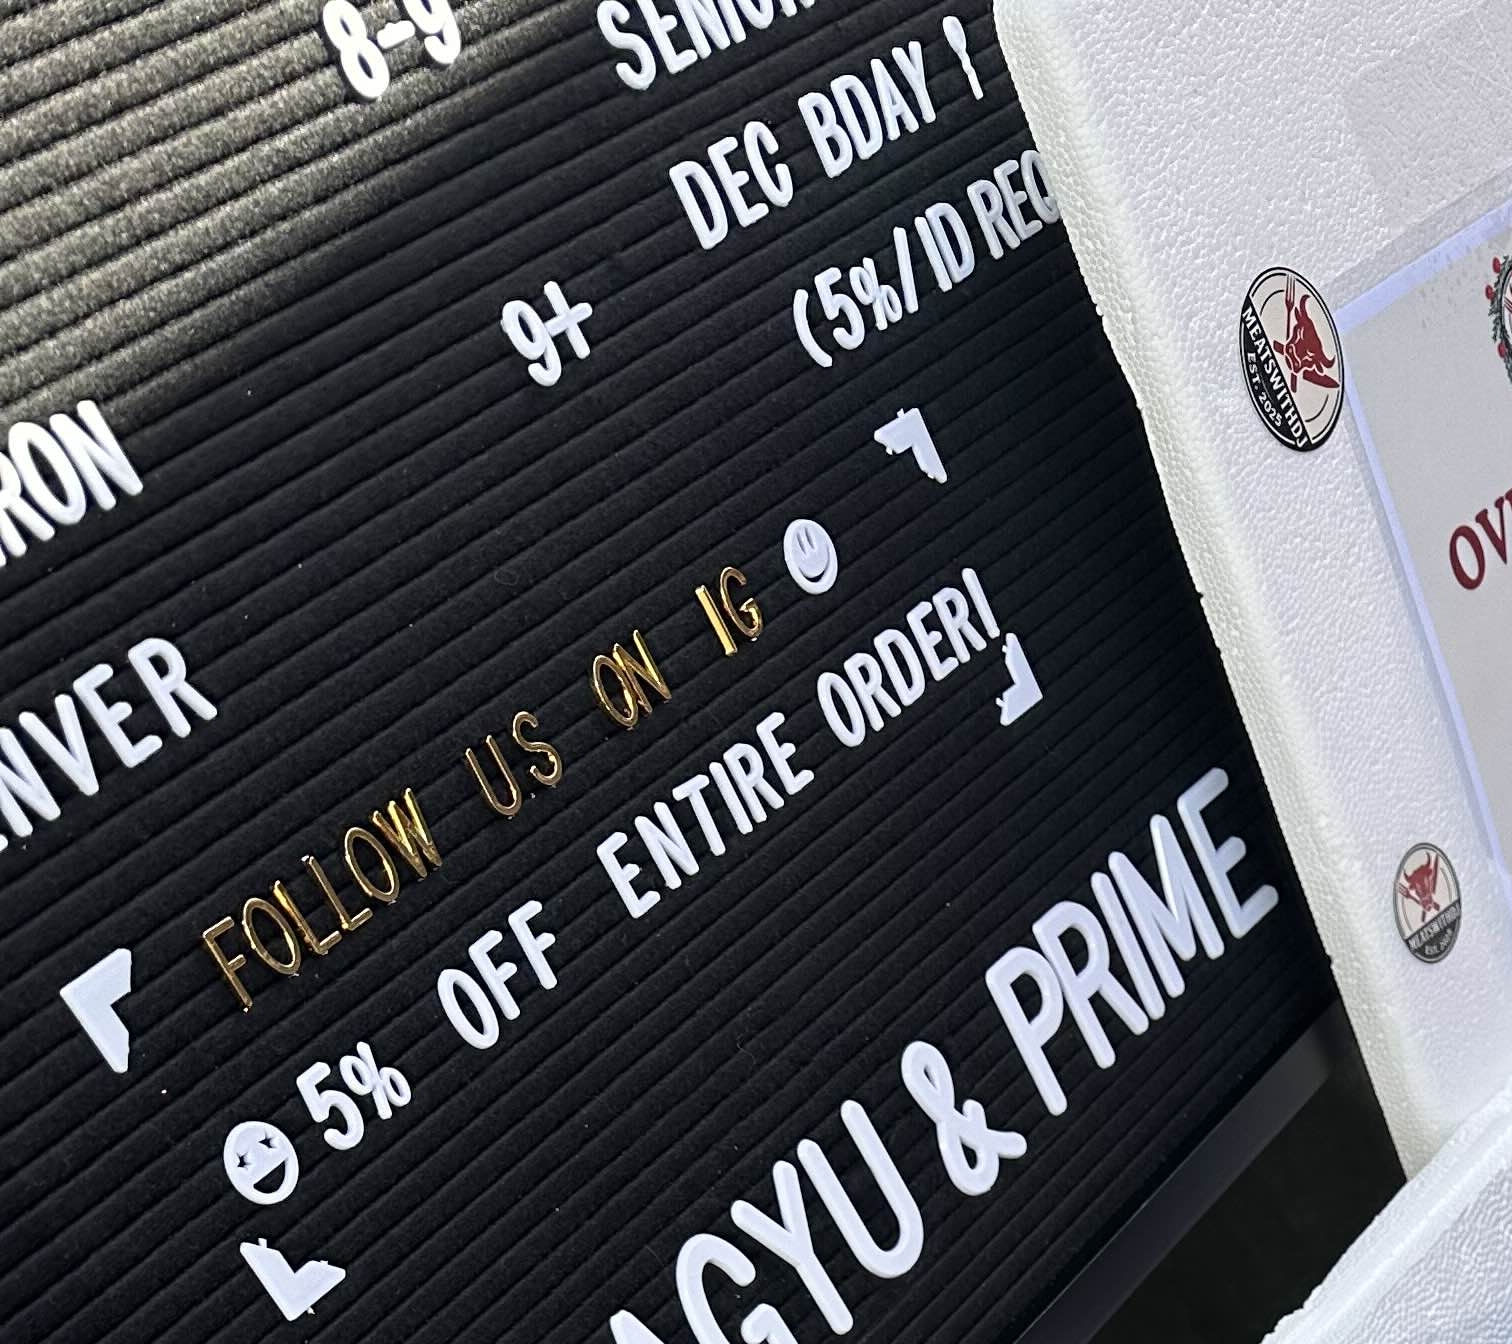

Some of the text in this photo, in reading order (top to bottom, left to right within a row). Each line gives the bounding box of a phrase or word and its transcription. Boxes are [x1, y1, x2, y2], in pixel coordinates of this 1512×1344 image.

[669, 121, 794, 250] DEC
[799, 41, 936, 178] BDAY
[501, 281, 593, 387] 9+
[1243, 307, 1308, 448] MEATSWITHDJ
[1258, 392, 1283, 427] 2025
[0, 400, 144, 567] RON
[0, 638, 217, 851] NVER
[202, 566, 763, 1012] FOLLOW US ON IG
[296, 1042, 411, 1150] 5%
[436, 900, 558, 1050] OFF
[596, 711, 815, 918] ENTIRE
[900, 1041, 1027, 1196] &
[984, 767, 1278, 1115] PRIME
